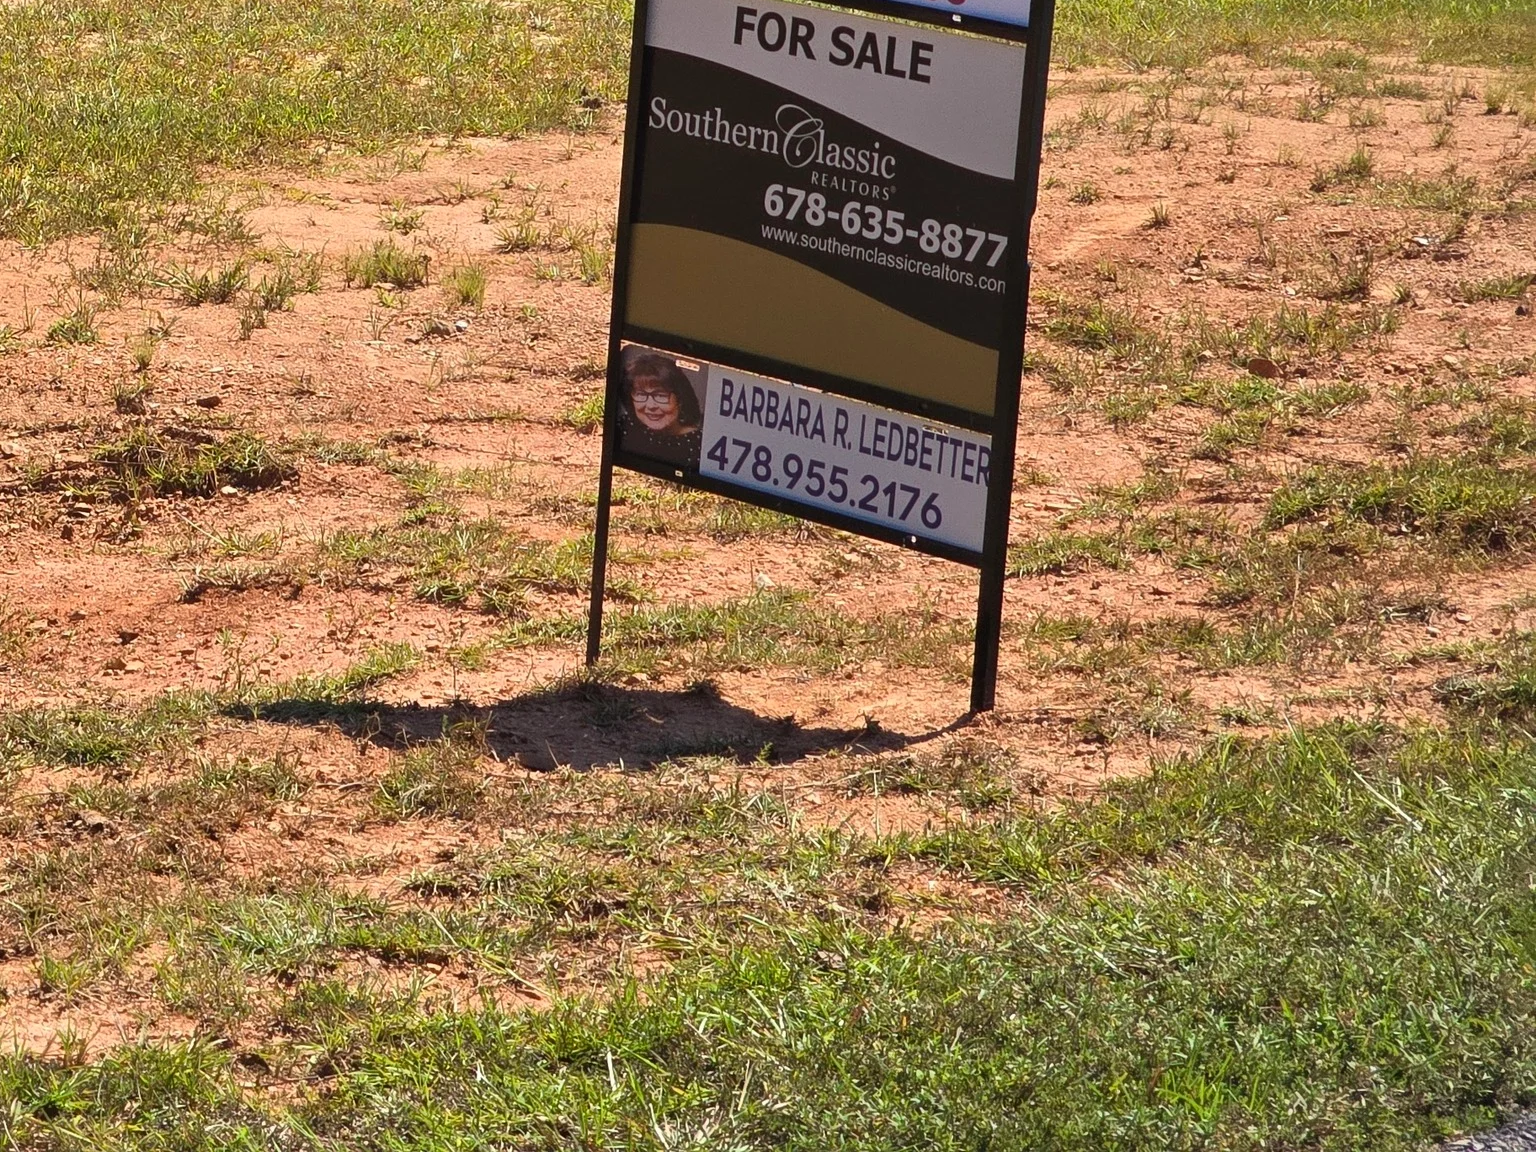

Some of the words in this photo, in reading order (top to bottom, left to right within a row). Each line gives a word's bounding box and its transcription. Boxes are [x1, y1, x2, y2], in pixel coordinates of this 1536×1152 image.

[733, 6, 816, 60] FOR
[828, 26, 934, 84] SALE
[648, 97, 780, 156] Southern
[775, 104, 896, 179] Classic
[763, 183, 1009, 268] 678-635-8877
[719, 377, 826, 444] BARBARA
[833, 408, 852, 450] R.
[860, 414, 992, 487] LEDBETTER
[707, 435, 943, 530] 478.955.2176
